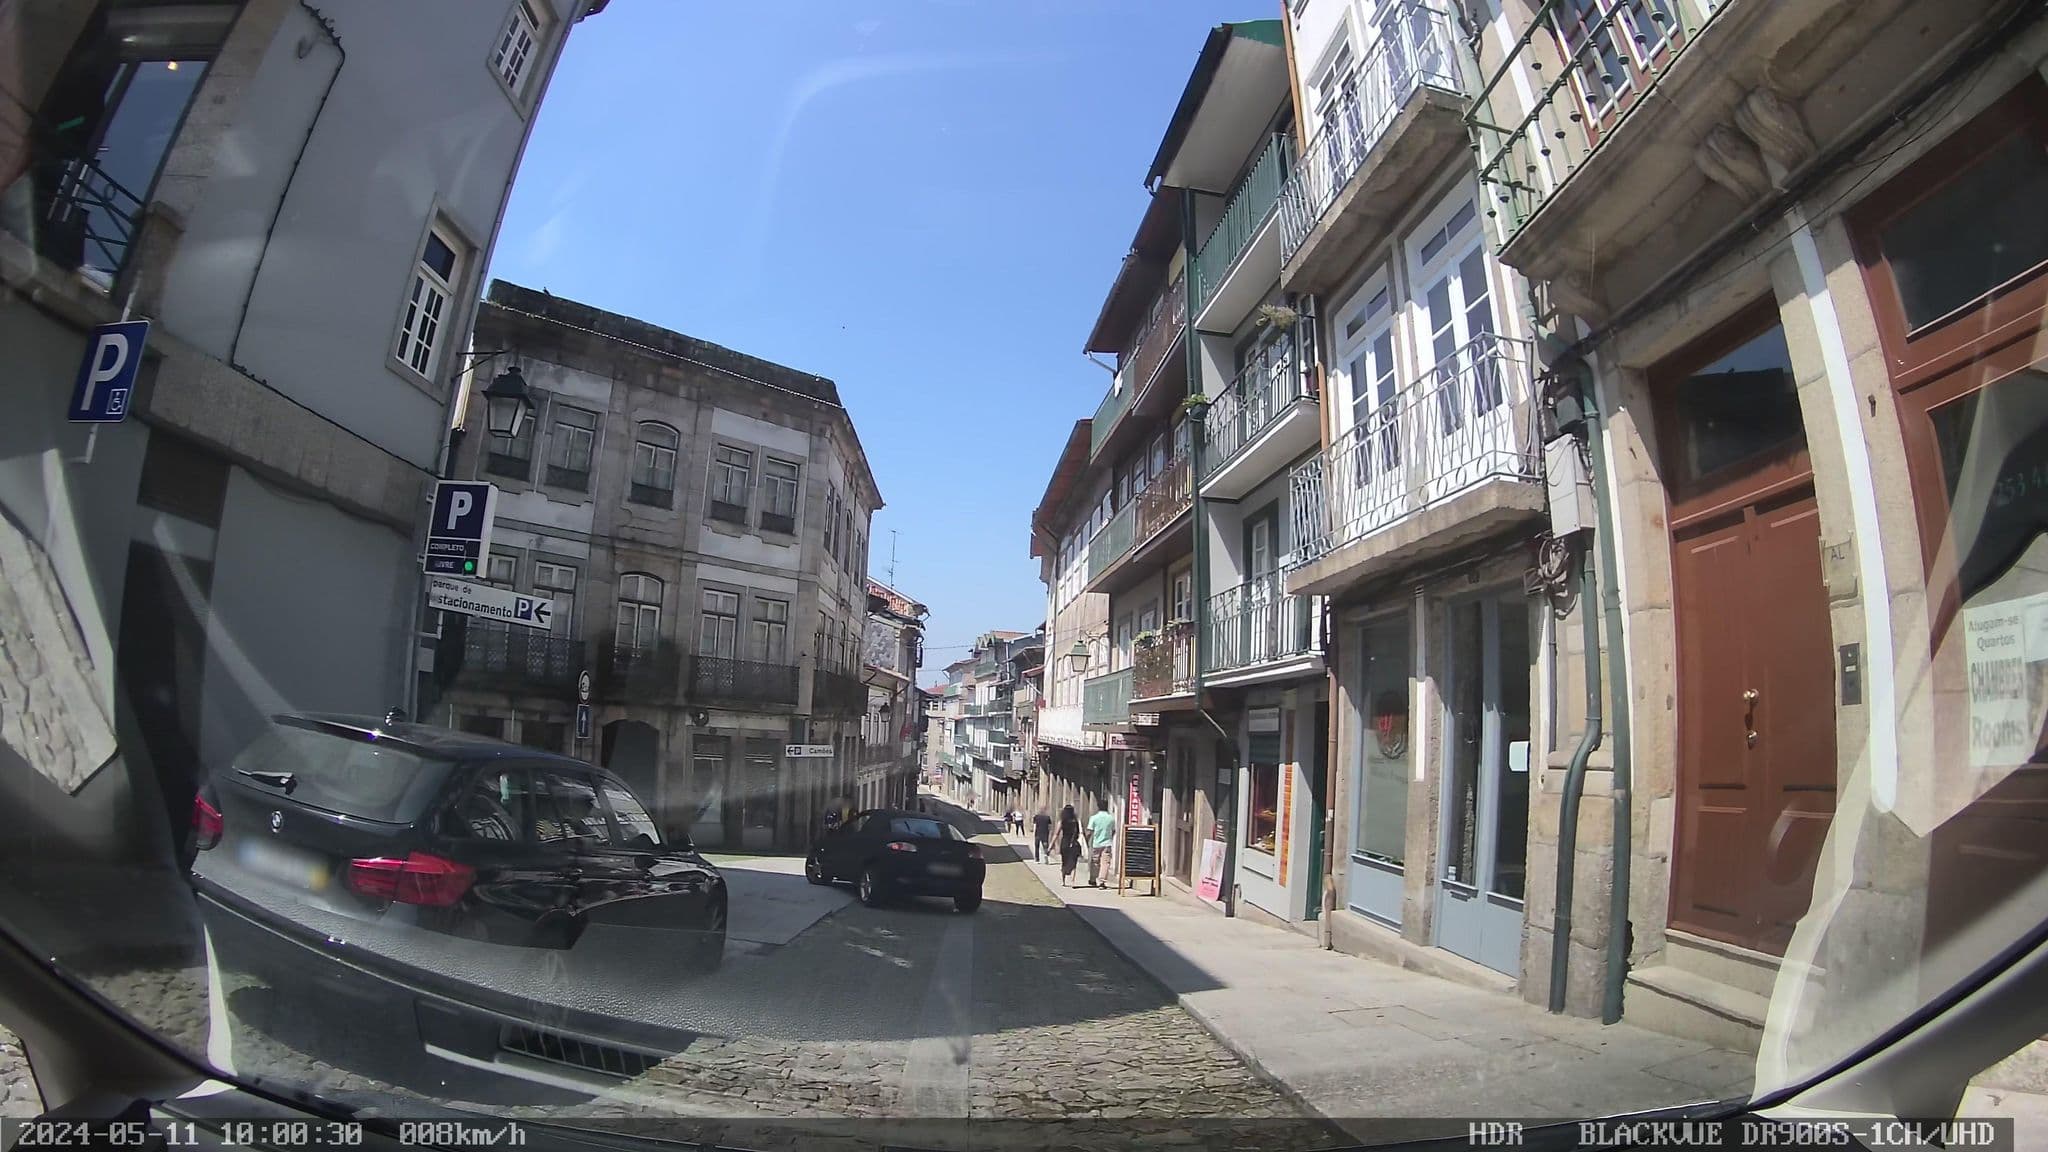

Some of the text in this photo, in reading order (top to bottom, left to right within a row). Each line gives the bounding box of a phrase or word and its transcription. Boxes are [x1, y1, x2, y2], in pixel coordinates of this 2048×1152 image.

[81, 333, 128, 411] P
[447, 491, 473, 530] P
[1831, 546, 1846, 560] AL
[432, 579, 472, 595] parque de
[433, 593, 530, 618] stacionamento P
[1976, 634, 2016, 652] Quartos
